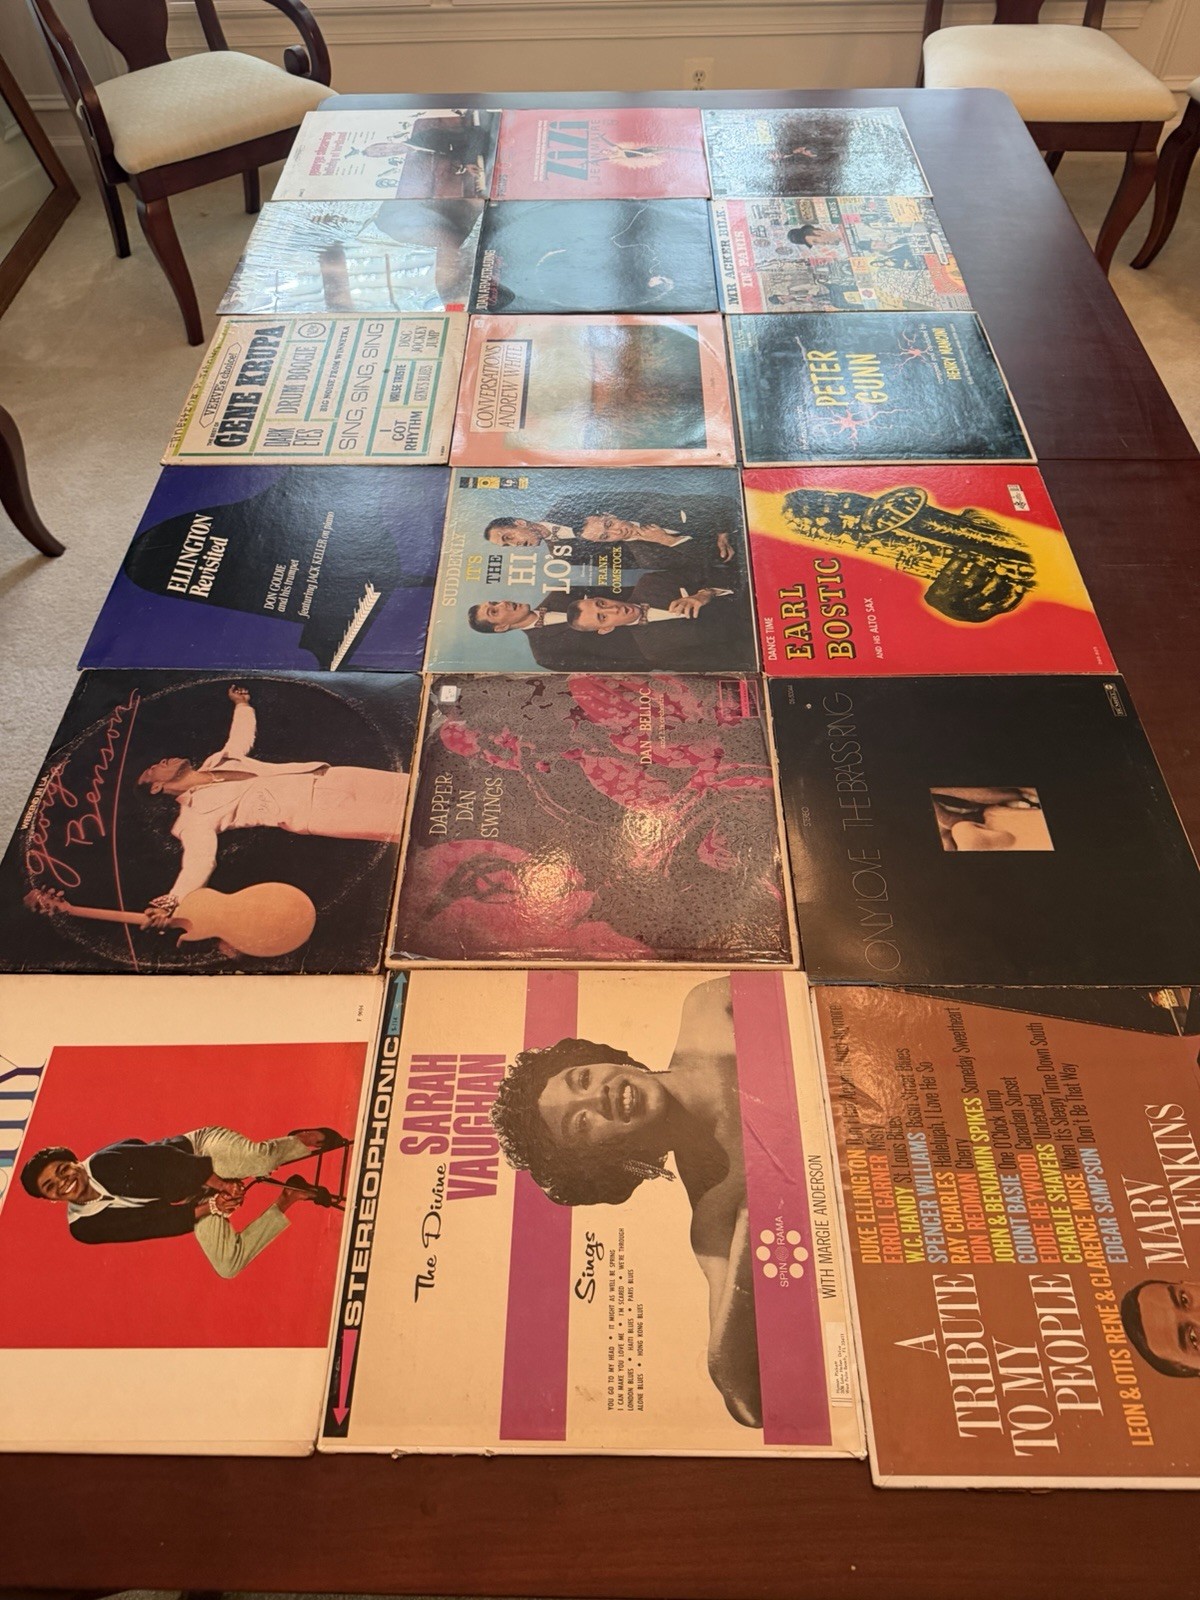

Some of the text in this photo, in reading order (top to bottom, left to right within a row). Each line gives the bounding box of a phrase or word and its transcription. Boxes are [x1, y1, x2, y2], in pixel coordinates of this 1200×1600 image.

[479, 250, 496, 293] ARMATRADING
[720, 240, 736, 280] ACKER
[725, 283, 739, 305] MR
[734, 231, 754, 287] IN PARIS
[398, 330, 412, 347] DISC
[411, 325, 427, 352] JOCKEY
[475, 294, 490, 310] JOAN
[320, 326, 350, 412] BIG NOISE FROM WINNETKA
[425, 330, 440, 348] JUMP
[933, 327, 961, 380] HENRY MANCINI
[204, 380, 227, 416] VERVE's
[220, 353, 237, 378] choice!
[214, 326, 285, 447] GENE KRUPA
[275, 346, 317, 414] DRUM BOOGIE
[338, 324, 384, 450] SING, SING, SING
[476, 345, 501, 428] CONVERSATIONS
[498, 345, 523, 429] ANDREW WHITE
[807, 350, 849, 406] PETER
[845, 354, 889, 403] GUNN
[263, 428, 295, 446] DARK
[293, 429, 323, 446] EYES
[392, 420, 407, 441] GOT
[404, 411, 422, 451] RHYTHM
[167, 513, 213, 593] ELLINGTON
[189, 536, 229, 598] Revisited
[263, 564, 286, 610] DON GOLDIE
[276, 559, 300, 612] and his trumpet
[297, 511, 334, 619] featuring JACK KELLER on piano
[442, 532, 465, 607] SUDDENLY
[466, 555, 483, 581] IT'S
[486, 554, 503, 584] THE
[508, 553, 537, 586] HI
[598, 555, 608, 586] FRANK
[612, 546, 622, 594] COMSTOCK
[764, 617, 778, 660] DANCE TIME
[779, 584, 815, 659] EARL
[813, 558, 856, 659] BOSTIC
[864, 598, 884, 659] AND HIS ALTO SAX
[639, 688, 652, 764] DAN BELLOC
[65, 688, 139, 847] Benson
[429, 772, 453, 835] DAPPER
[19, 798, 41, 831] WEEKEND
[35, 786, 45, 796] IN
[455, 790, 476, 821] DAN
[480, 778, 504, 837] SWINGS
[801, 806, 812, 826] STEREO
[823, 692, 901, 971] ONLY LOVE THE BRASS RING
[944, 1006, 980, 1094] Someday Sweetheart
[400, 1054, 457, 1155] SARAH
[895, 1047, 924, 1128] Basin Blues
[1001, 1076, 1034, 1150] Canadian Sunset
[1023, 1093, 1052, 1140] Undecided
[446, 1054, 506, 1201] VAUGHAN
[928, 1122, 952, 1167] Hallelujah,
[954, 1138, 975, 1169] Cherry
[343, 1035, 400, 1328] STEREOPHONIC
[907, 1132, 948, 1264] SPENCER WILLIAMS
[963, 1097, 1016, 1264] JOHN BENJAMIN SPIKES
[1144, 1103, 1200, 1230] JENKINS
[414, 1163, 446, 1303] The Divine
[809, 1154, 837, 1299] WITH MARGIE ANDERSON
[846, 1149, 881, 1264] DUKE ELLINGTON
[869, 1155, 903, 1264] ERROLL GARNER
[895, 1186, 925, 1264] W.C. HANDY
[935, 1171, 971, 1264] RAY CHARLES
[958, 1173, 993, 1264] DON REDMAN
[1000, 1173, 1038, 1264] COUNT BASIE
[1017, 1154, 1061, 1264] EDDIE HEYWOOD
[1036, 1144, 1083, 1264] CHARLIE SHAVERS
[1079, 1148, 1129, 1263] EDGAR SAMPSON
[1121, 1174, 1189, 1269] MARV
[574, 1231, 604, 1304] Sings
[775, 1216, 789, 1287] SPIN RAMA
[894, 1328, 940, 1358] A
[1028, 1274, 1104, 1416] PEOPLE
[1064, 1172, 1155, 1447] LEON OTIS RENÉ CLARENCE MUSE
[932, 1273, 1004, 1438] TRIBUTE
[992, 1335, 1060, 1456] TO MY
